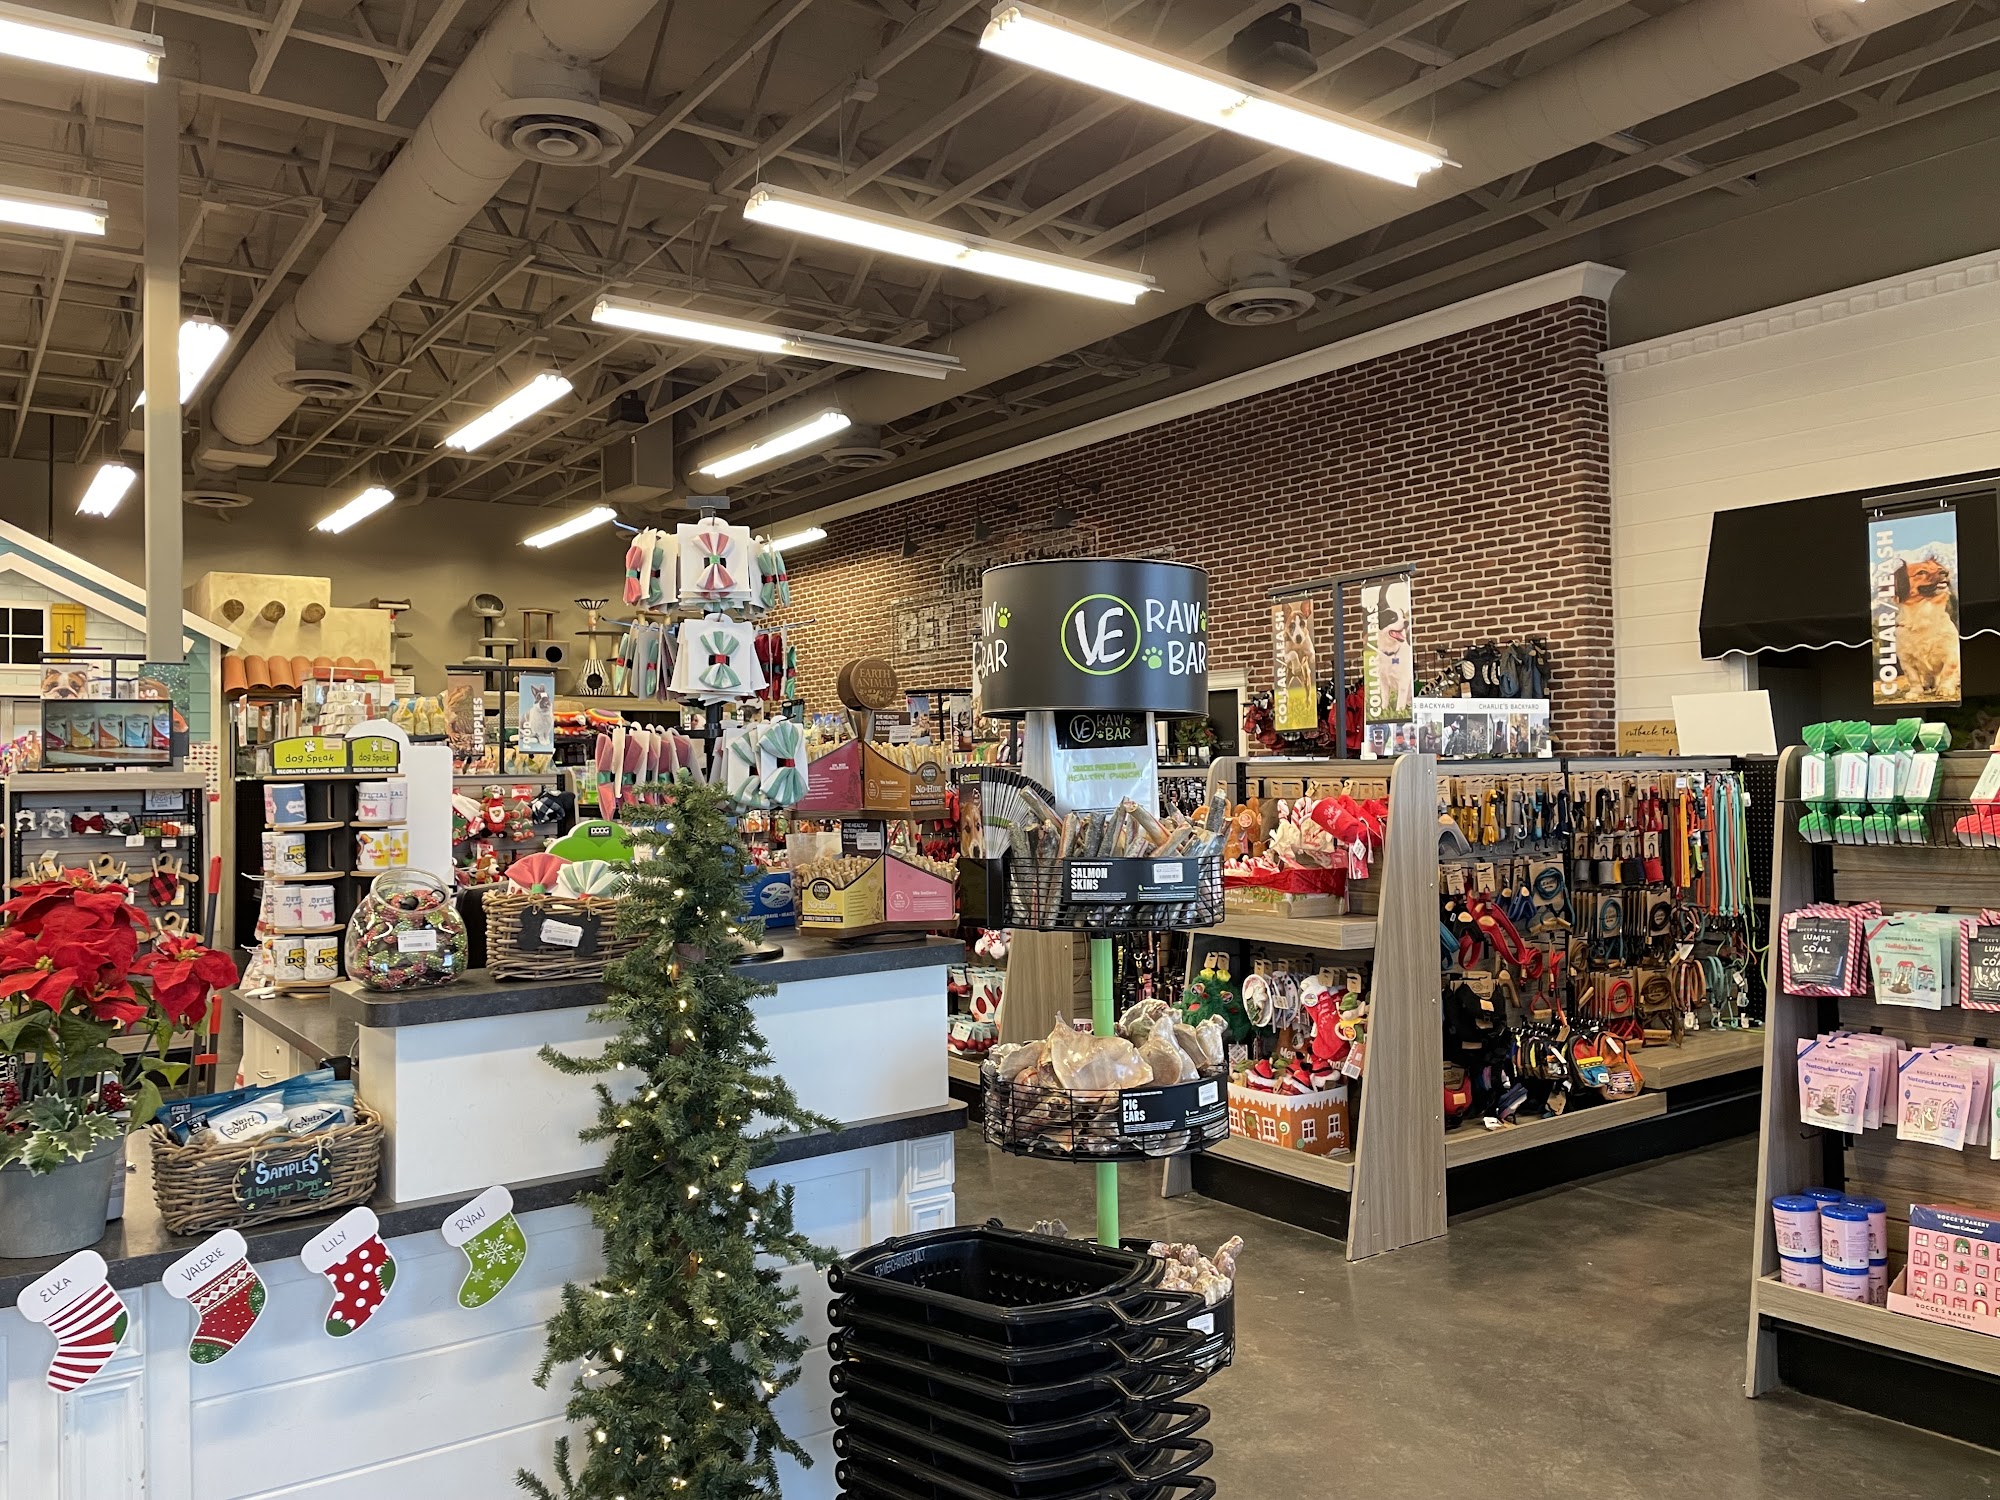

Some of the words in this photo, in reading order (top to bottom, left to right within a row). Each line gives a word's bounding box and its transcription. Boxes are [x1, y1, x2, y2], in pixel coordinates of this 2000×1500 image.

[1145, 598, 1200, 634] RAW
[1877, 530, 1898, 695] COLLAR/LEASH
[981, 640, 1008, 679] BAR
[1168, 640, 1206, 676] BAR
[1367, 604, 1382, 718] COLLAR/LEAS
[860, 668, 890, 678] EARTH
[1275, 611, 1288, 724] COLLAR/LEASH
[856, 678, 894, 688] ANIMAL
[473, 698, 484, 752] SUPPLIES
[1097, 714, 1124, 727] RAW
[522, 721, 532, 749] FOOD
[1105, 727, 1131, 740] BAR
[1662, 726, 1678, 736] tail
[286, 754, 304, 764] dog
[1068, 772, 1106, 782] HEALTHY
[1070, 868, 1108, 879] SALMON
[1070, 879, 1099, 890] SKINS
[1802, 934, 1832, 942] LUMPS
[1802, 946, 1830, 954] COAL
[1982, 958, 2000, 966] COA
[1806, 1062, 1839, 1073] Nutcracker
[1840, 1068, 1863, 1076] Crunch
[1908, 1076, 1941, 1086] Nutcracker
[1942, 1082, 1966, 1090] Crunch
[171, 1104, 190, 1112] FREE
[1122, 1099, 1138, 1112] PIG
[301, 1112, 324, 1124] Nutri
[1123, 1110, 1146, 1123] EARS
[255, 1153, 319, 1184] SAMPLES
[244, 1187, 255, 1200] 1
[256, 1186, 276, 1198] bag
[278, 1182, 294, 1195] per
[295, 1178, 322, 1191] Doggo
[454, 1206, 486, 1232] RYAN
[1937, 1214, 1964, 1224] BOCCE'S
[1966, 1219, 1990, 1228] BAKERY
[1942, 1222, 1960, 1230] Advent
[1960, 1225, 1984, 1234] Calendar
[322, 1230, 347, 1253] LILY
[180, 1247, 226, 1282] VALERIE
[40, 1277, 72, 1302] ELKA
[1916, 1302, 1946, 1314] BOCCE'S
[1948, 1310, 1976, 1320] BAKERY
